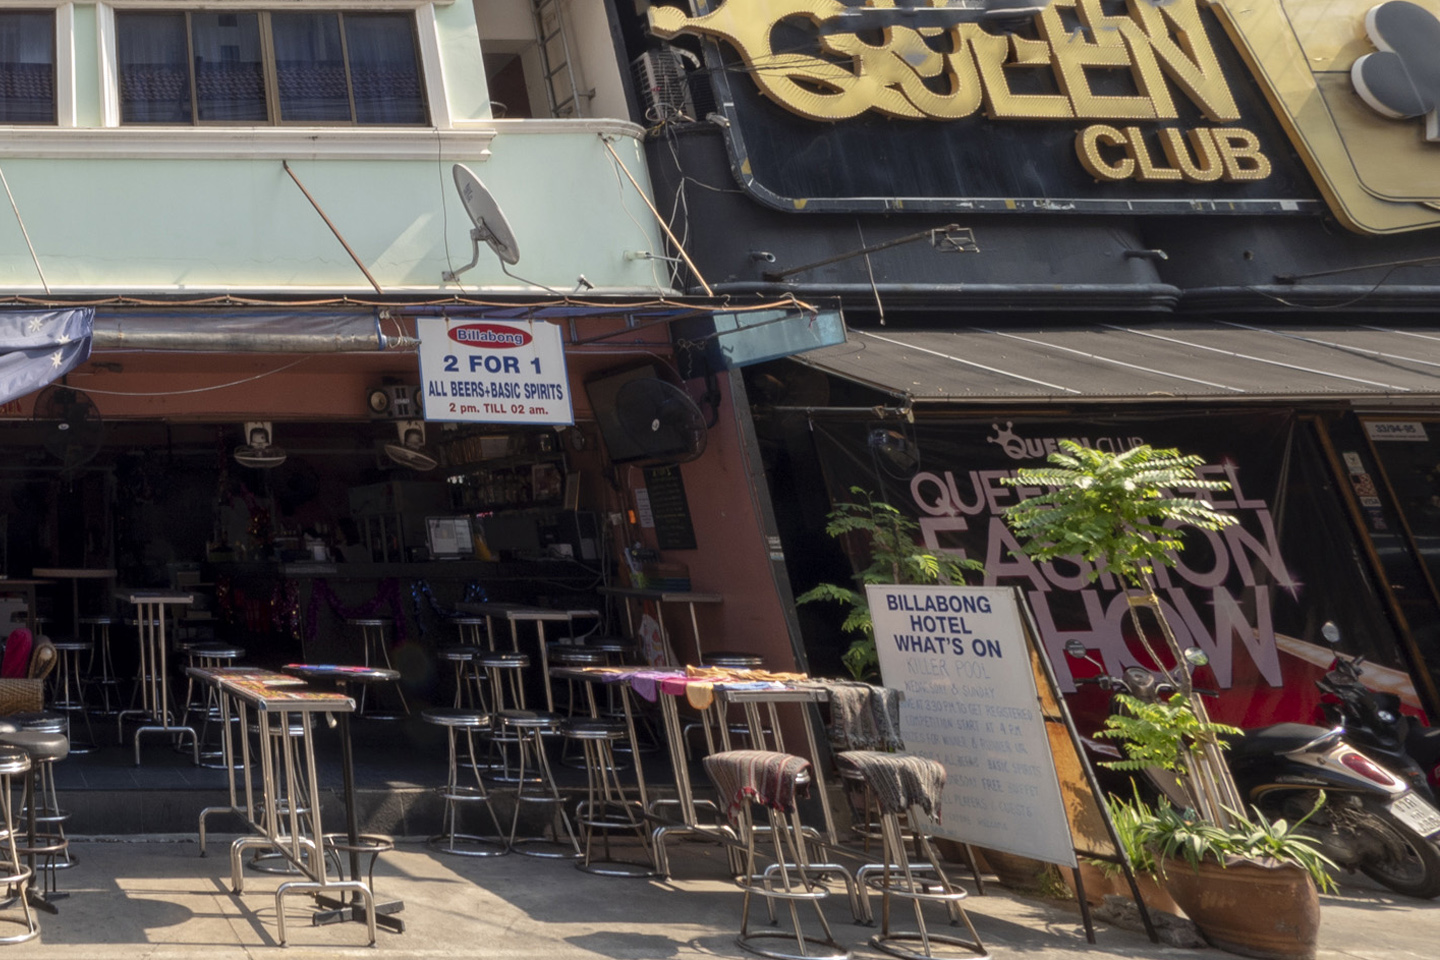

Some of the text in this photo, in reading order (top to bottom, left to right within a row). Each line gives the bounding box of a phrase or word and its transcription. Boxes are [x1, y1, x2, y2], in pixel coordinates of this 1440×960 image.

[1074, 123, 1273, 182] CLUB
[456, 328, 524, 346] Billabong
[443, 354, 542, 375] 2 FOR 1
[428, 380, 448, 397] ALL
[524, 383, 564, 401] SPIRITS
[449, 402, 549, 415] 2 pm. TILL 02 am.
[886, 594, 992, 614] BILLABONG
[909, 614, 973, 635] HOTEL
[893, 634, 1003, 658] WHAT'S ON
[1028, 585, 1283, 693] HOW
[906, 657, 992, 680] KILLER POOL
